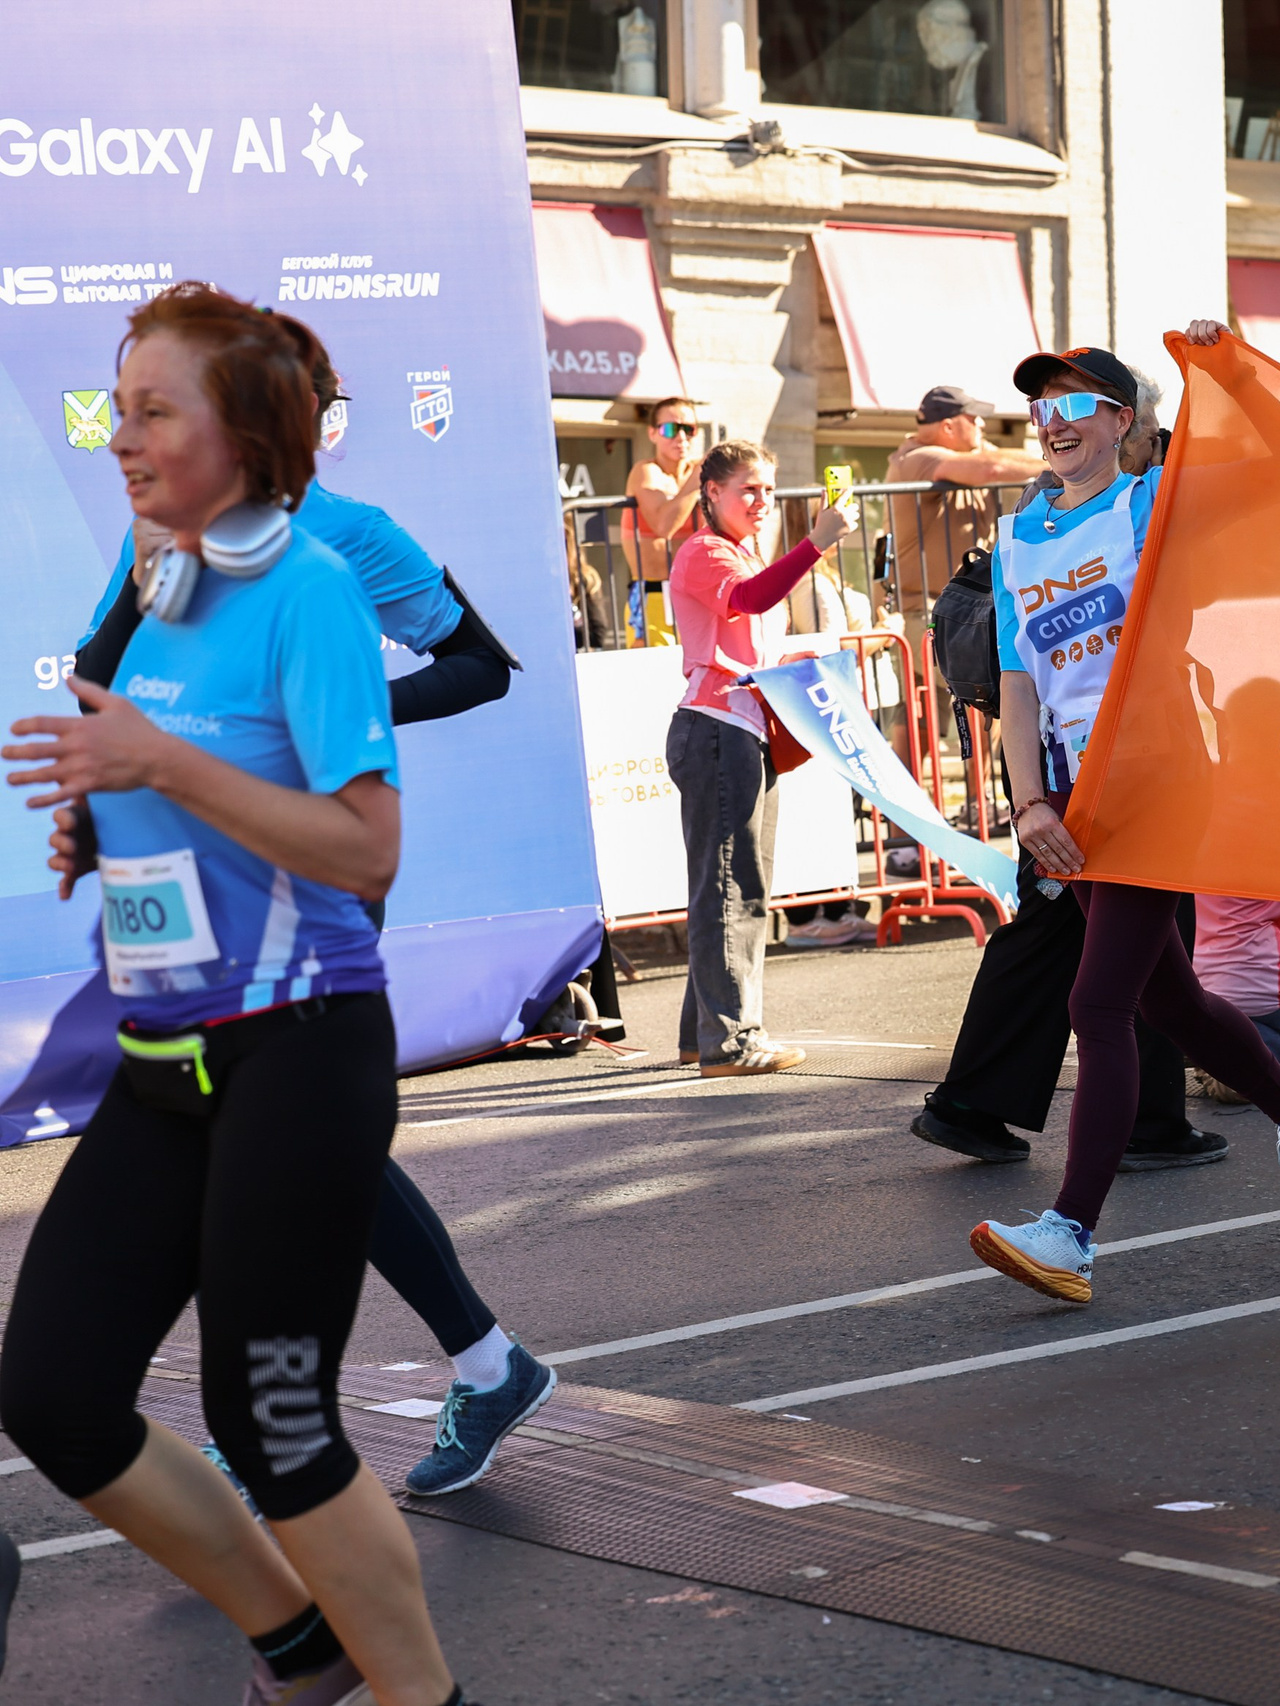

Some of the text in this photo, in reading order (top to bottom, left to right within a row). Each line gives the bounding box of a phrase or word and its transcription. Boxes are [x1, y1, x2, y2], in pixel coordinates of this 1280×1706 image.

[0, 117, 286, 193] Galaxy AI
[60, 262, 173, 284] ЦИФРОВАЯ И
[282, 253, 373, 270] БЕГОВОЙ КЛУБ
[62, 284, 141, 304] БЫТОВАЯ
[278, 272, 440, 301] RUNDNSRUN
[406, 368, 451, 383] ГЕРОЙ
[415, 396, 448, 423] ГТО
[1018, 556, 1108, 615] DNS
[1039, 594, 1106, 639] СПОРТ
[806, 680, 864, 755] DNS
[247, 1336, 332, 1476] RUN
